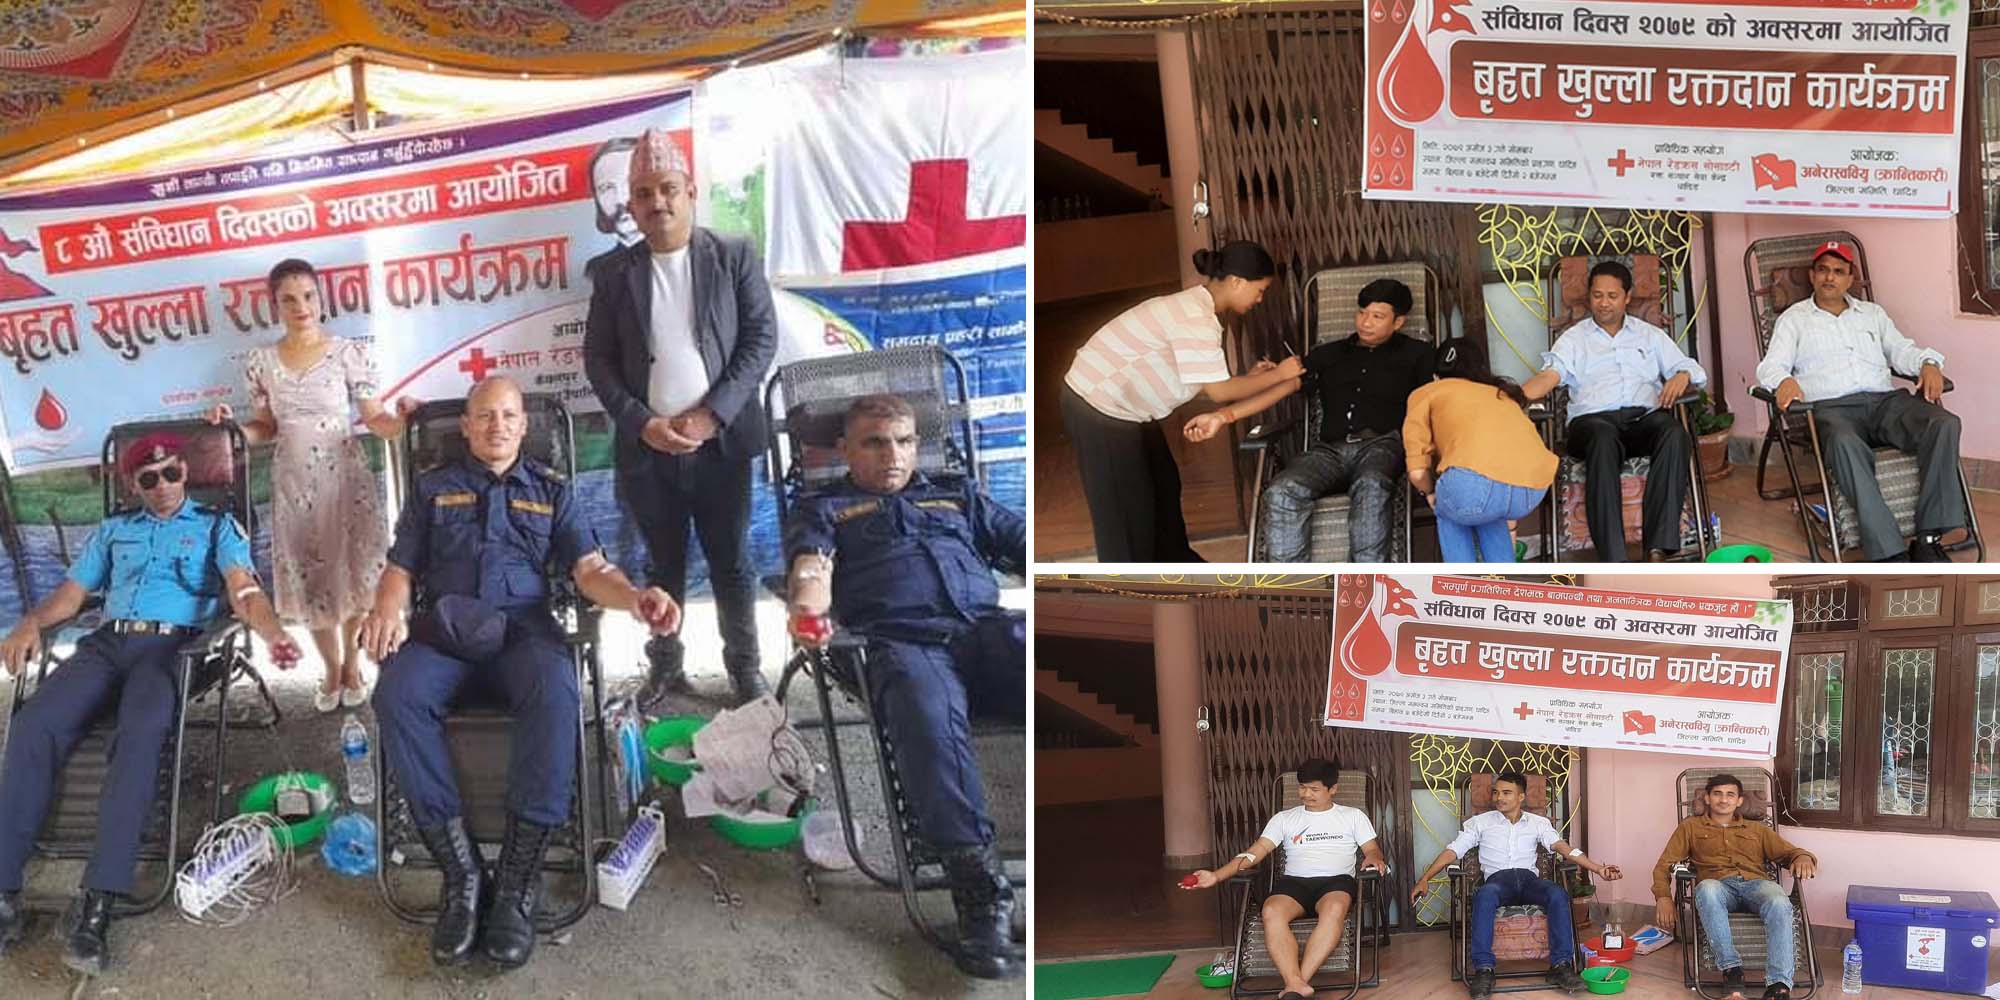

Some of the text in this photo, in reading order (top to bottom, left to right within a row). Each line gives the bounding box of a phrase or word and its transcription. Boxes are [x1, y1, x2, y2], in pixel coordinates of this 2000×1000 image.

[1482, 5, 1950, 43] संविधान दिवस २०७९ को अवसरमा आयोजित
[1472, 61, 1950, 118] बृहत खुल्ला रक्तदान कार्यक्रम
[120, 217, 212, 257] संविधान
[216, 194, 317, 242] दिवसको
[325, 184, 438, 228] अवसरमा
[446, 160, 568, 209] आयोजित
[87, 286, 209, 360] खुल्ला
[383, 233, 568, 309] कार्यक्रम
[1423, 600, 1778, 642] संविधान दिवस २०७९ को अवसरमा आयोजित
[1414, 636, 1775, 689] बृहत खुल्ला रक्तदान कार्यक्रम
